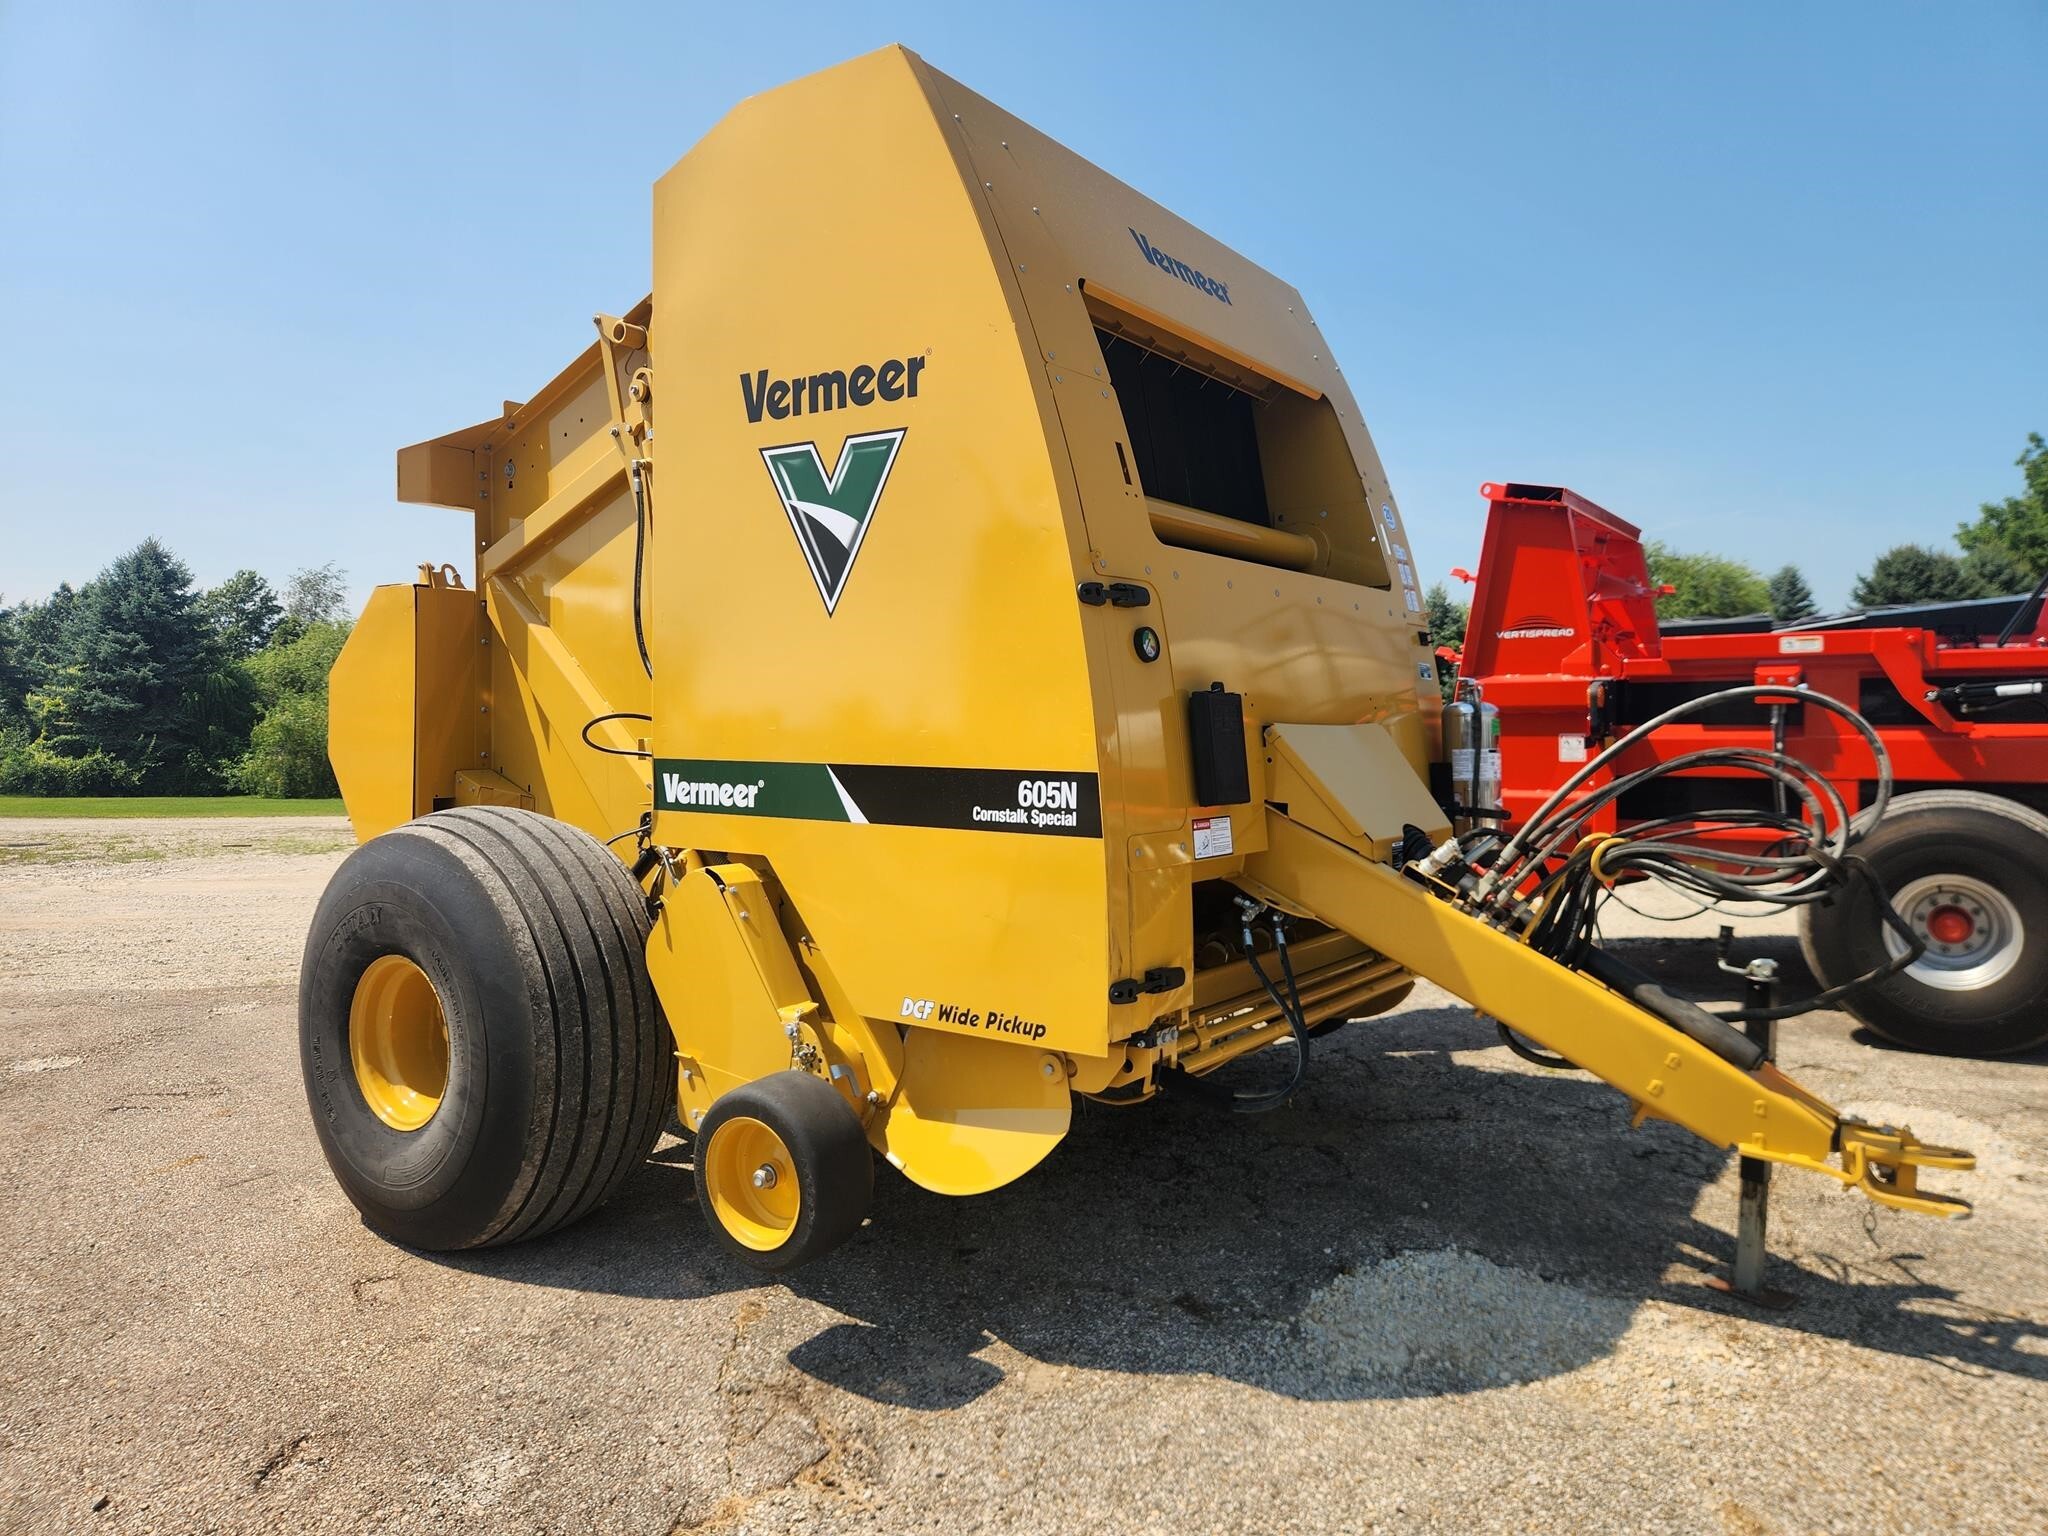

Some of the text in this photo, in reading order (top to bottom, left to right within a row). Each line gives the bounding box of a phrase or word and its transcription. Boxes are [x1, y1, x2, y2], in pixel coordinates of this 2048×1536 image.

[1127, 226, 1232, 306] Vermeer
[740, 354, 926, 424] Vermeer
[1496, 628, 1574, 639] VERTISPREAD
[662, 773, 759, 808] Vermeer
[1017, 780, 1078, 809] 605N
[972, 806, 1077, 828] Cornstalk Special
[900, 997, 1047, 1041] DCF Wide Pickup
